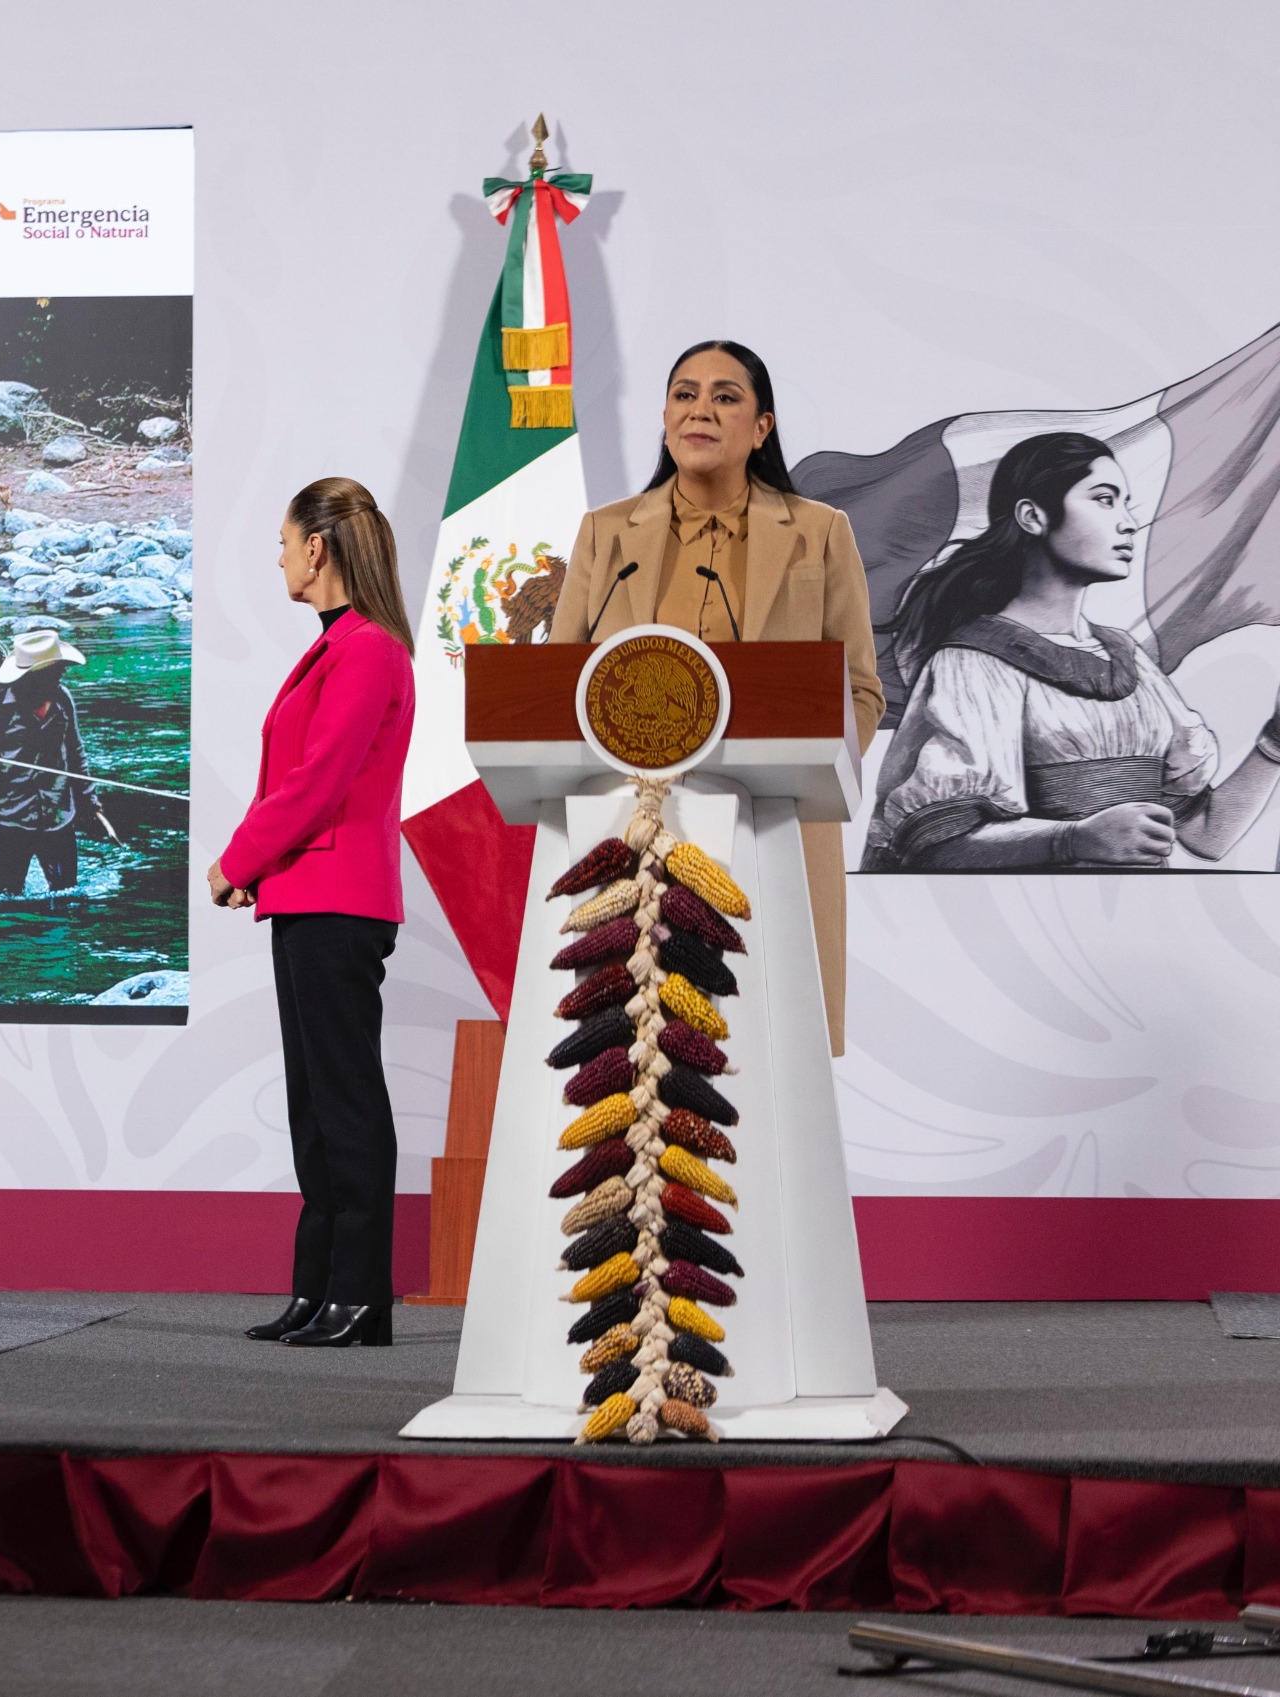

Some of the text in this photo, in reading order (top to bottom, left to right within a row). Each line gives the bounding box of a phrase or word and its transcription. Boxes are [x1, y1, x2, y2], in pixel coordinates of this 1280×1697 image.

[23, 198, 65, 206] Programa
[23, 205, 149, 228] Emergencia
[23, 225, 149, 239] Social o Natural
[589, 638, 716, 702] ESTADOS UNIDOS MEXICANOS
